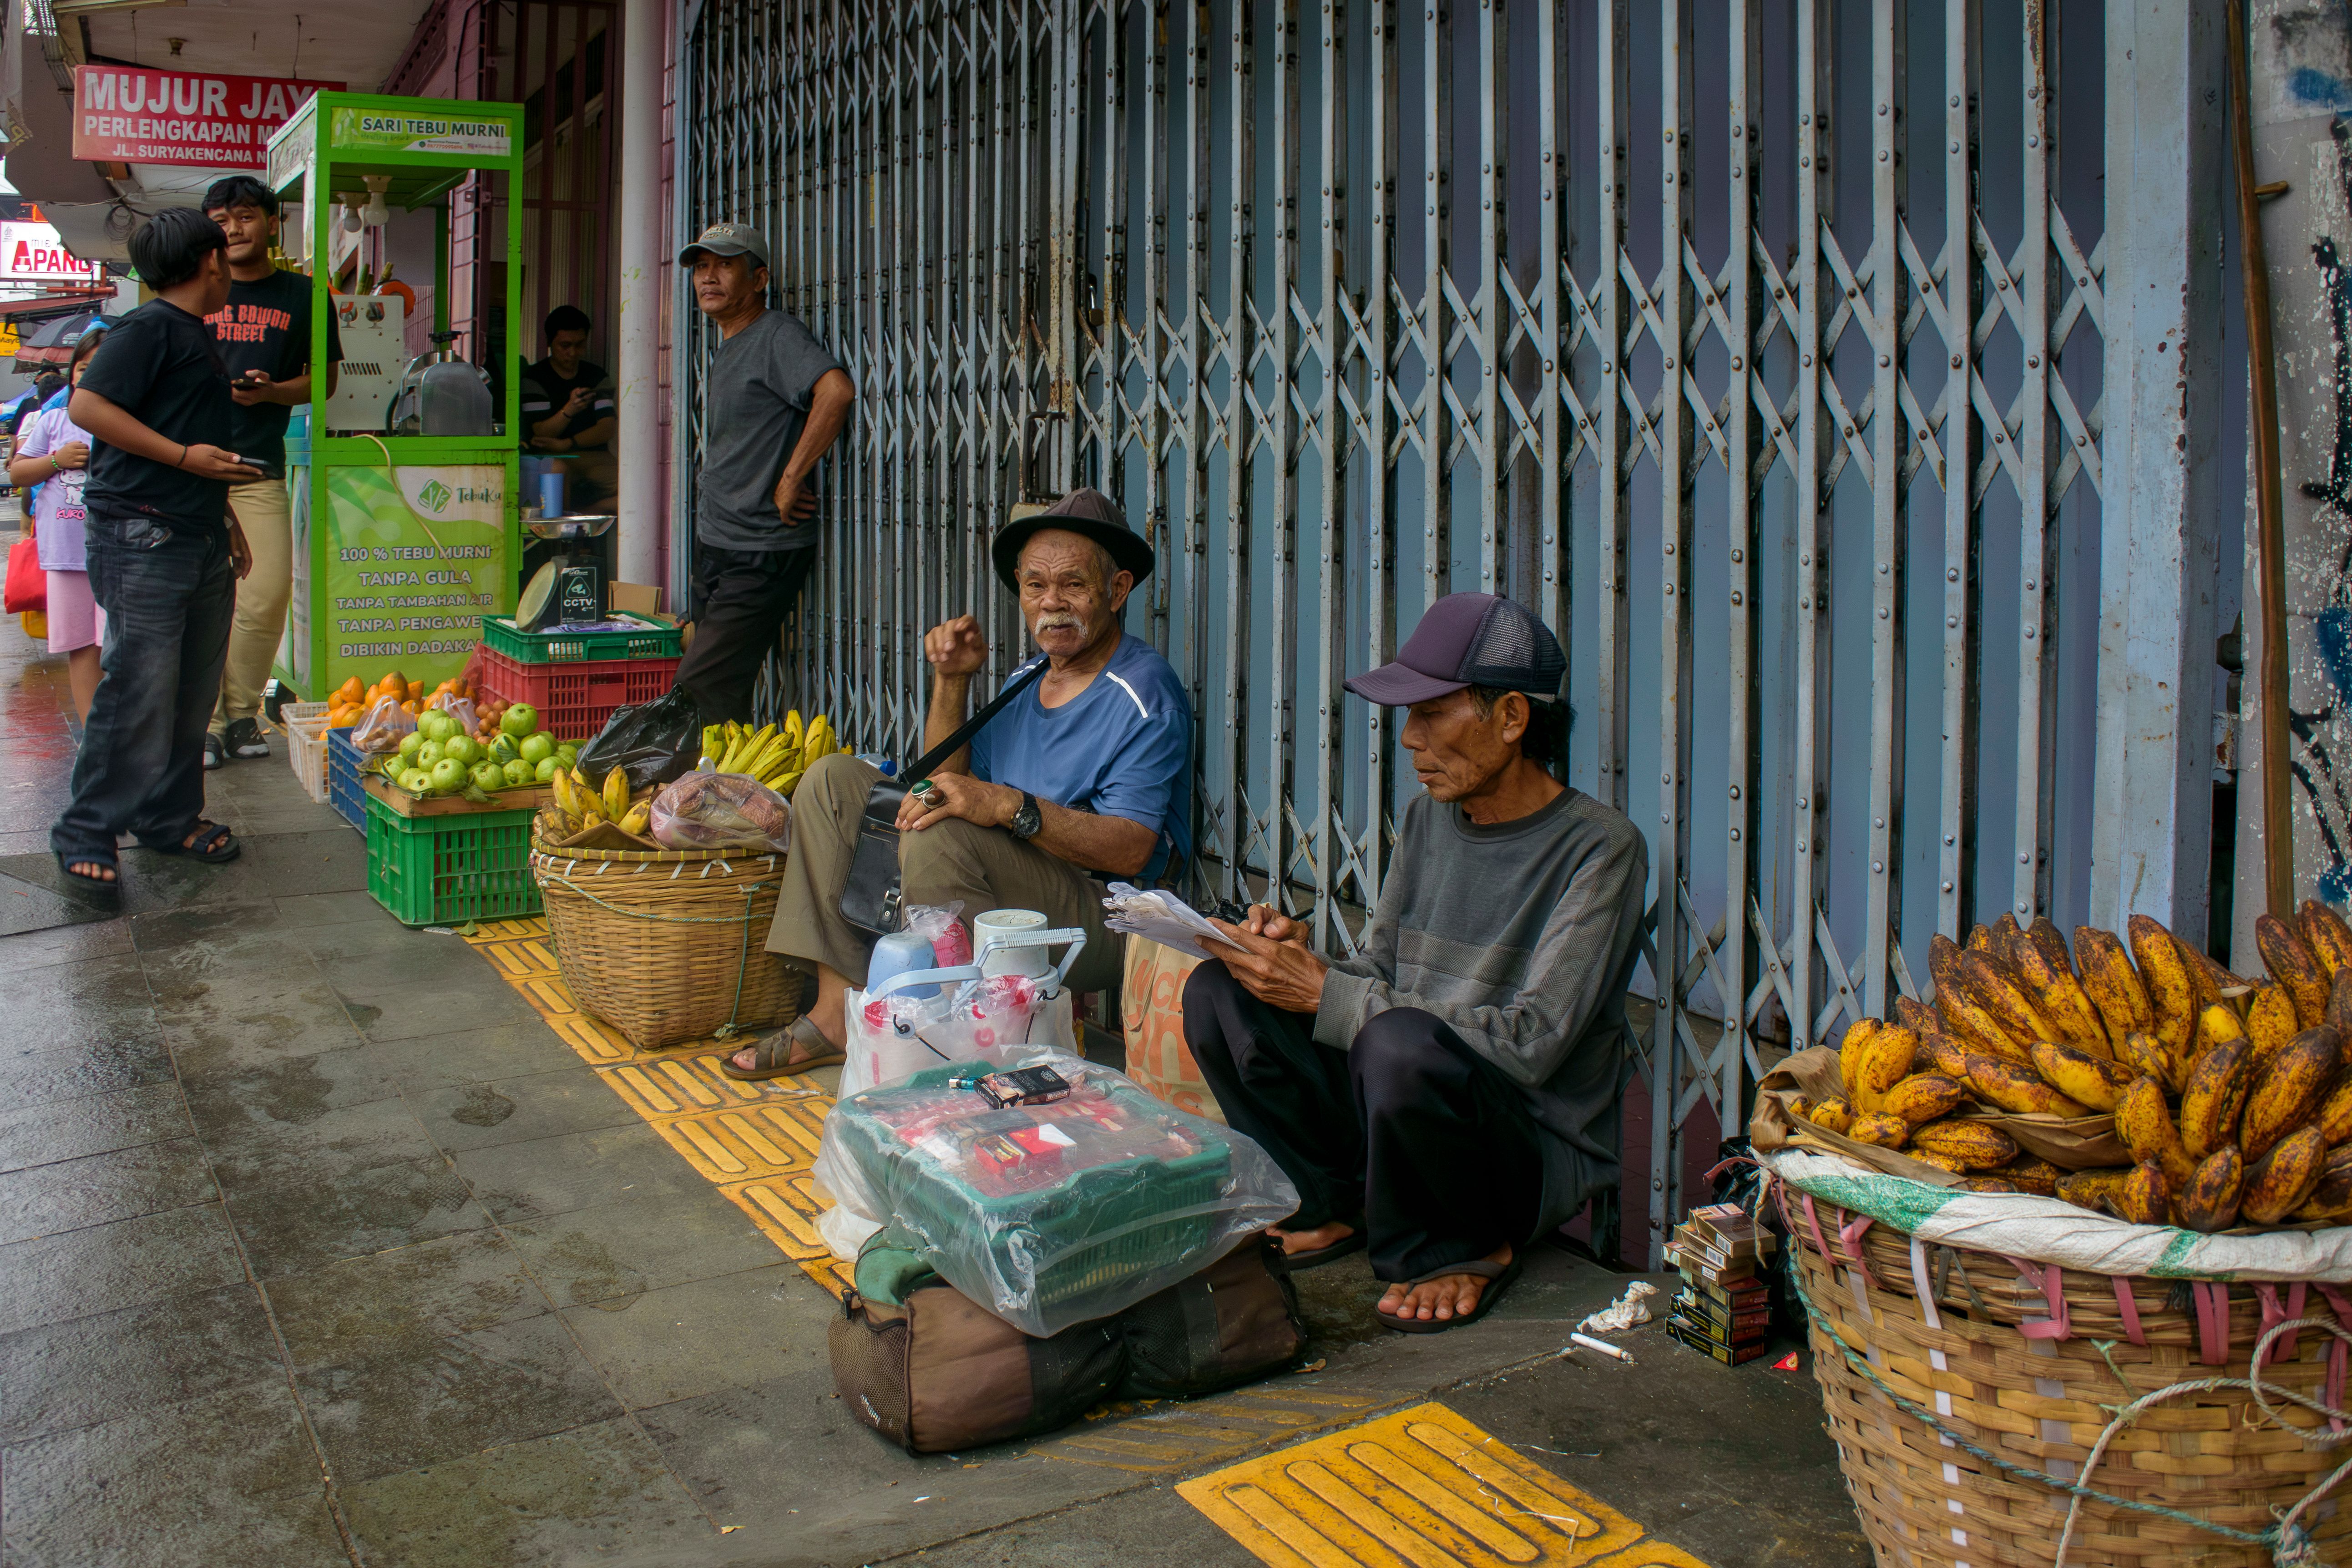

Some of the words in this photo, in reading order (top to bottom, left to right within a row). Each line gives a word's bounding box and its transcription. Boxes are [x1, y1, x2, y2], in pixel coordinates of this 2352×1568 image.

[85, 72, 228, 117] MUJUR
[240, 82, 315, 120] JAY
[85, 116, 250, 144] PERLENGKAPAN
[257, 125, 279, 145] M
[362, 117, 400, 132] SARI
[406, 119, 446, 134] TEBU
[451, 122, 504, 137] MURNI
[112, 144, 134, 157] JL.
[138, 145, 253, 162] SURYAKENCANA
[217, 322, 268, 342] STREET
[56, 507, 86, 520] KURO
[340, 548, 369, 561] 100
[372, 547, 389, 561] %
[392, 546, 435, 560] TEBU
[439, 546, 491, 559] MURNI
[358, 572, 420, 586] TANPA
[425, 570, 472, 584] GULA
[336, 597, 385, 609] TANPA
[388, 594, 466, 607] TAMBAHAN
[469, 593, 493, 606] AIR
[564, 598, 593, 607] CCTV
[338, 619, 396, 632] TANPA
[340, 642, 402, 657] DIBIKIN
[407, 639, 480, 654] DADAKA
